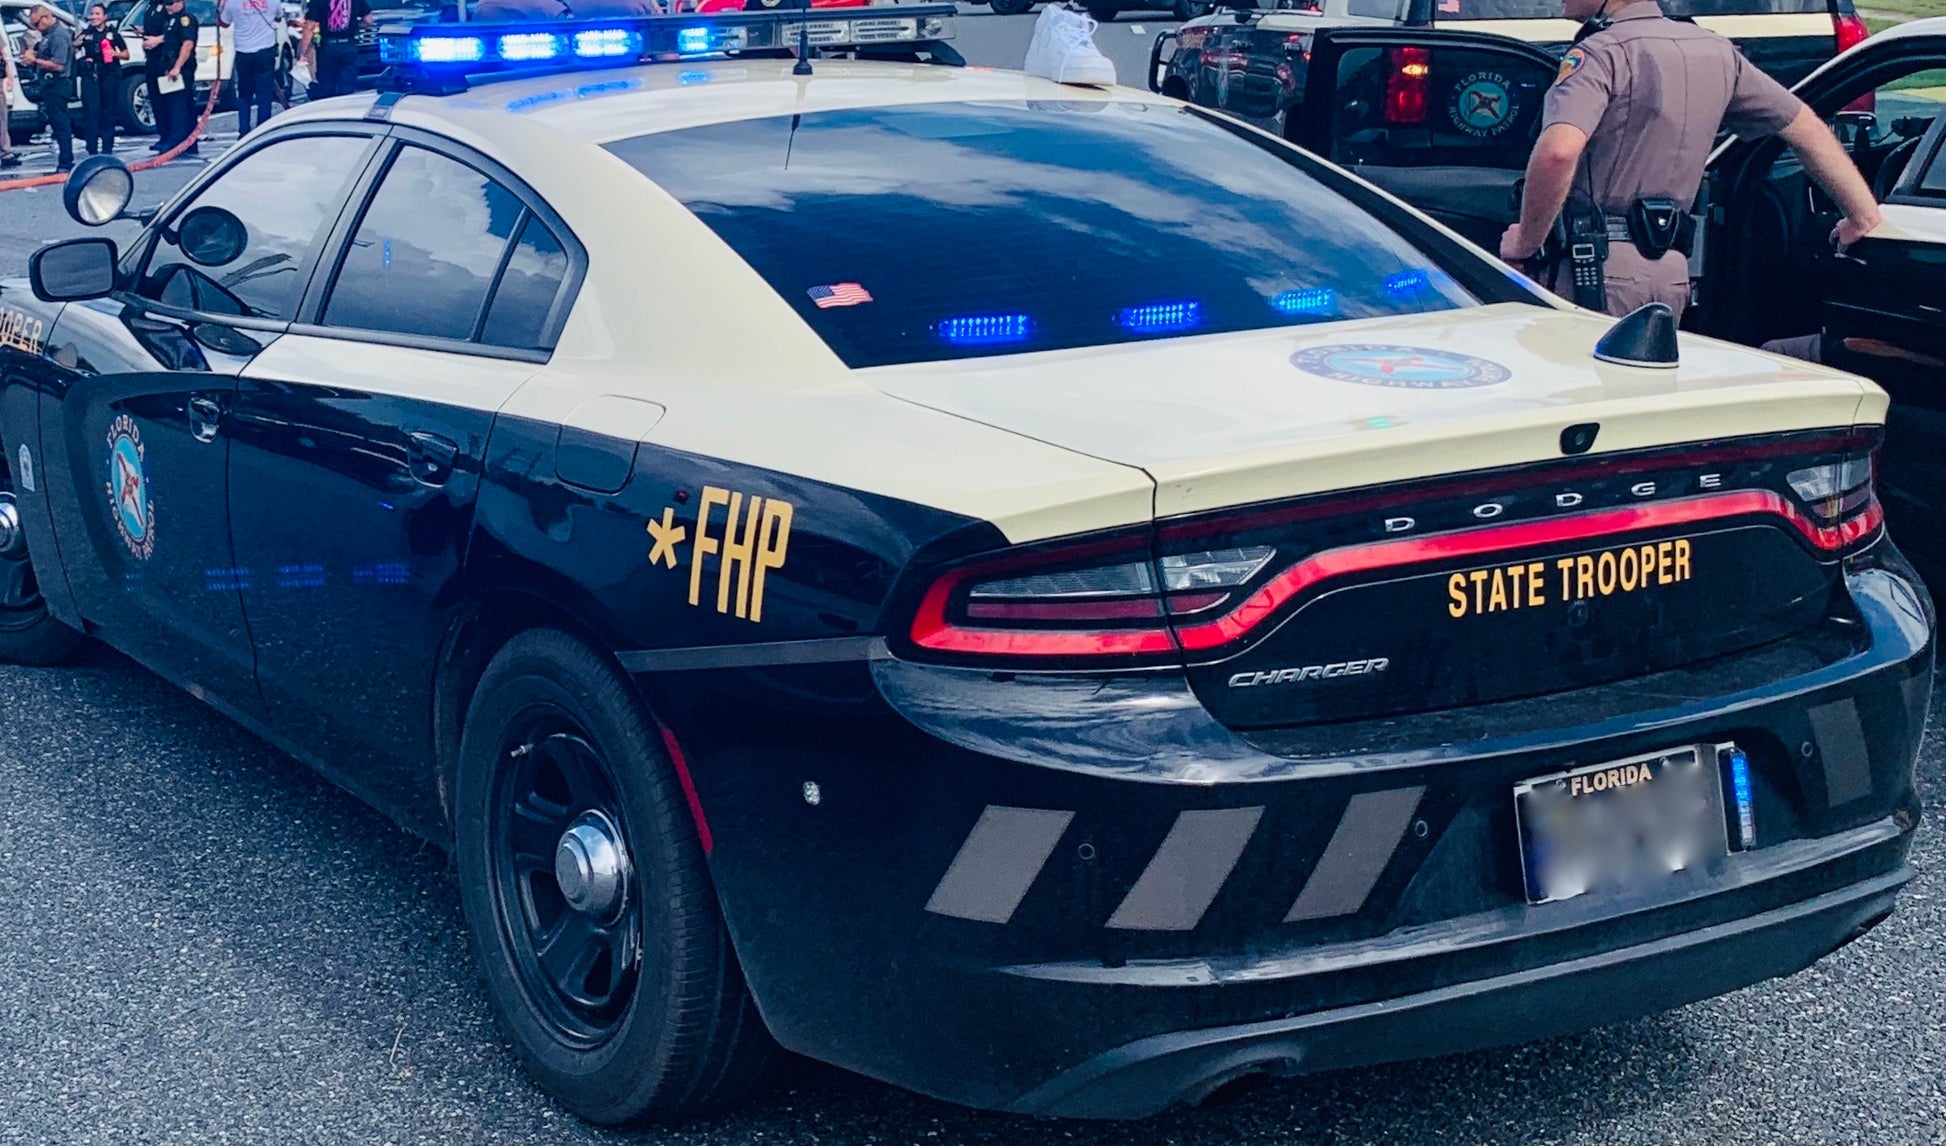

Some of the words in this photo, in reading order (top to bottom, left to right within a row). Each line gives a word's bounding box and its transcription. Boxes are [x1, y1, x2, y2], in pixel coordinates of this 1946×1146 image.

[1454, 71, 1512, 92] FLORIDA
[1449, 106, 1488, 137] HIGHWAY
[1491, 105, 1520, 137] PATROL
[106, 414, 145, 463] FLORIDA
[1385, 473, 1722, 533] DODGE
[1448, 562, 1545, 618] STATE
[1557, 539, 1691, 601] TROOPER
[1228, 657, 1390, 688] CHARGER
[1571, 763, 1653, 796] FLORIDA
